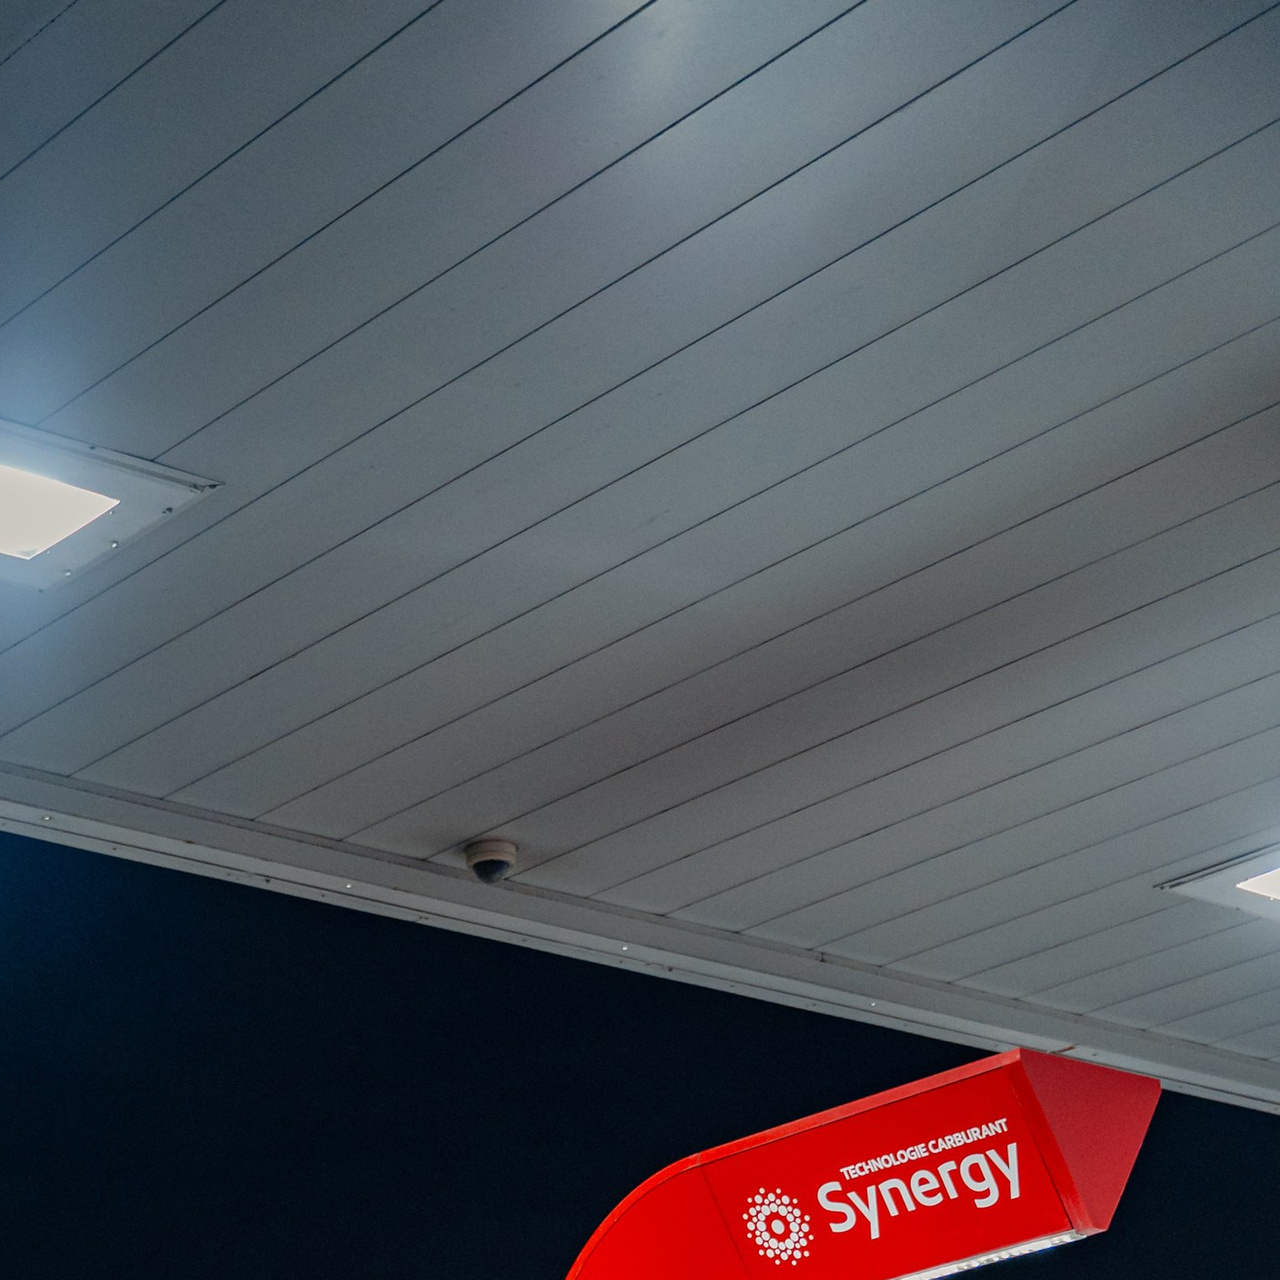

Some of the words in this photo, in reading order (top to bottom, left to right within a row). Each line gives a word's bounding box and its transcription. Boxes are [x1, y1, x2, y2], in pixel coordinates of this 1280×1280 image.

[840, 1144, 929, 1181] TECHNOLOGIE
[928, 1118, 1009, 1157] CARBURANT
[817, 1142, 1021, 1239] Synergy
